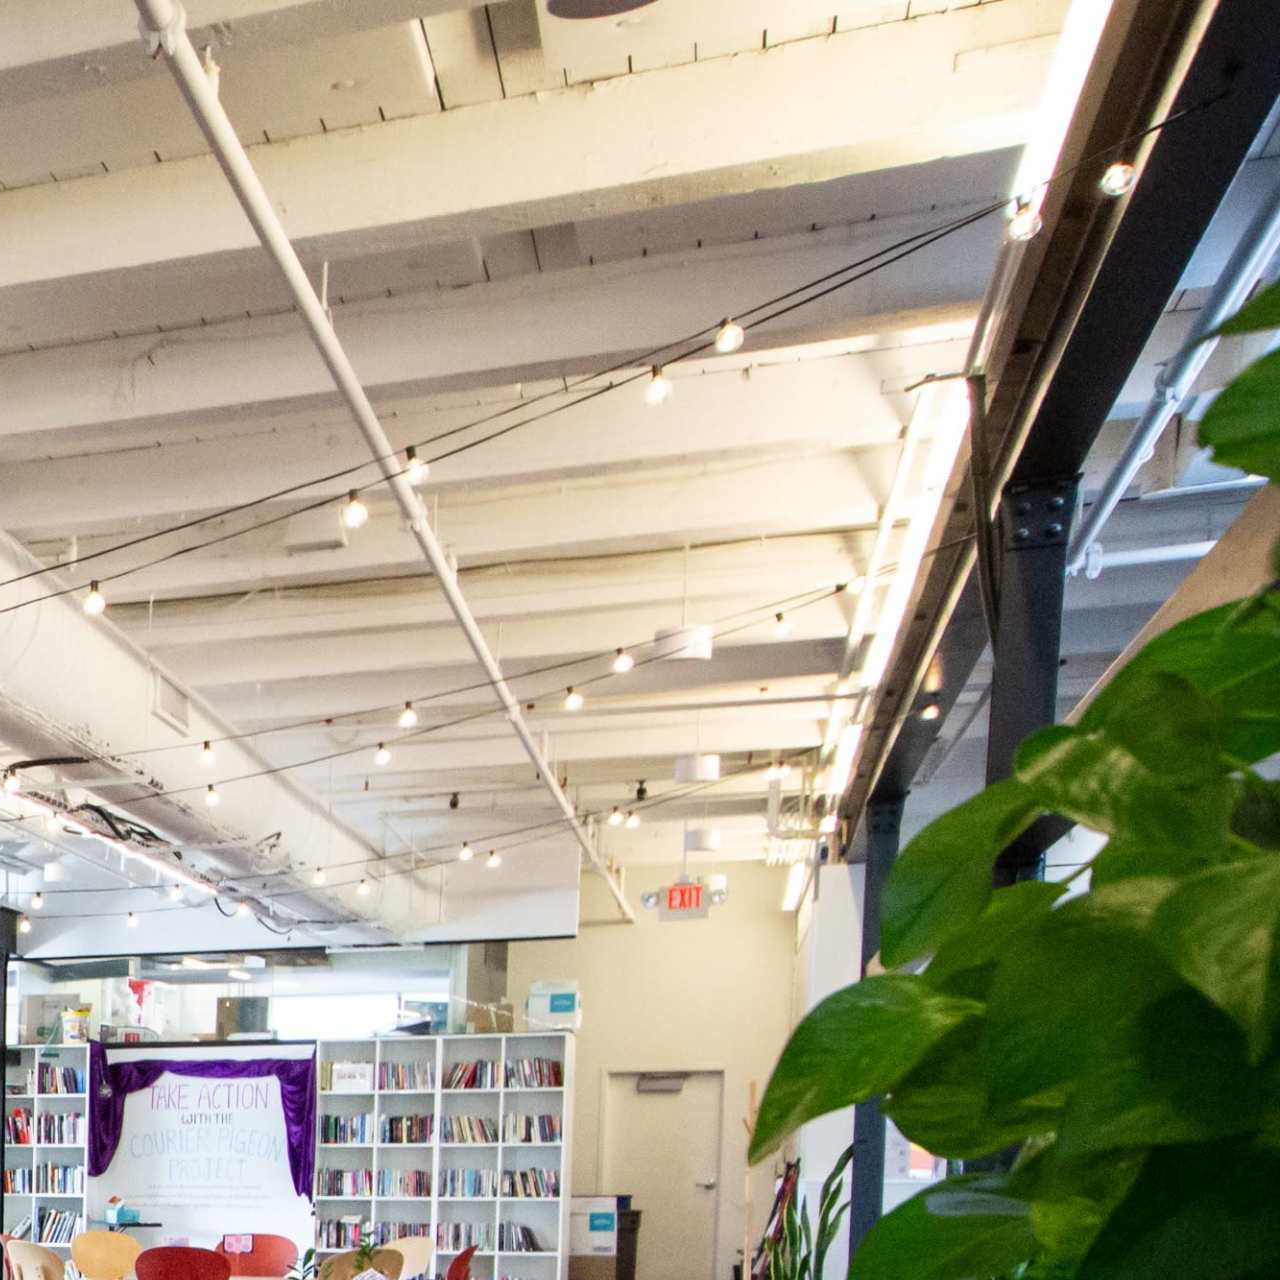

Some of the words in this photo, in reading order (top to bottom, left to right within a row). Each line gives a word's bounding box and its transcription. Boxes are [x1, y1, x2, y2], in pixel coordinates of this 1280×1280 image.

[669, 886, 703, 910] EXIT
[150, 1083, 190, 1111] TAKE
[198, 1083, 270, 1110] ACTION
[181, 1112, 212, 1125] WITH
[215, 1112, 233, 1125] THE
[130, 1127, 210, 1158] COURIER
[217, 1128, 284, 1162] PIGEON
[168, 1158, 248, 1180] PROJECT
